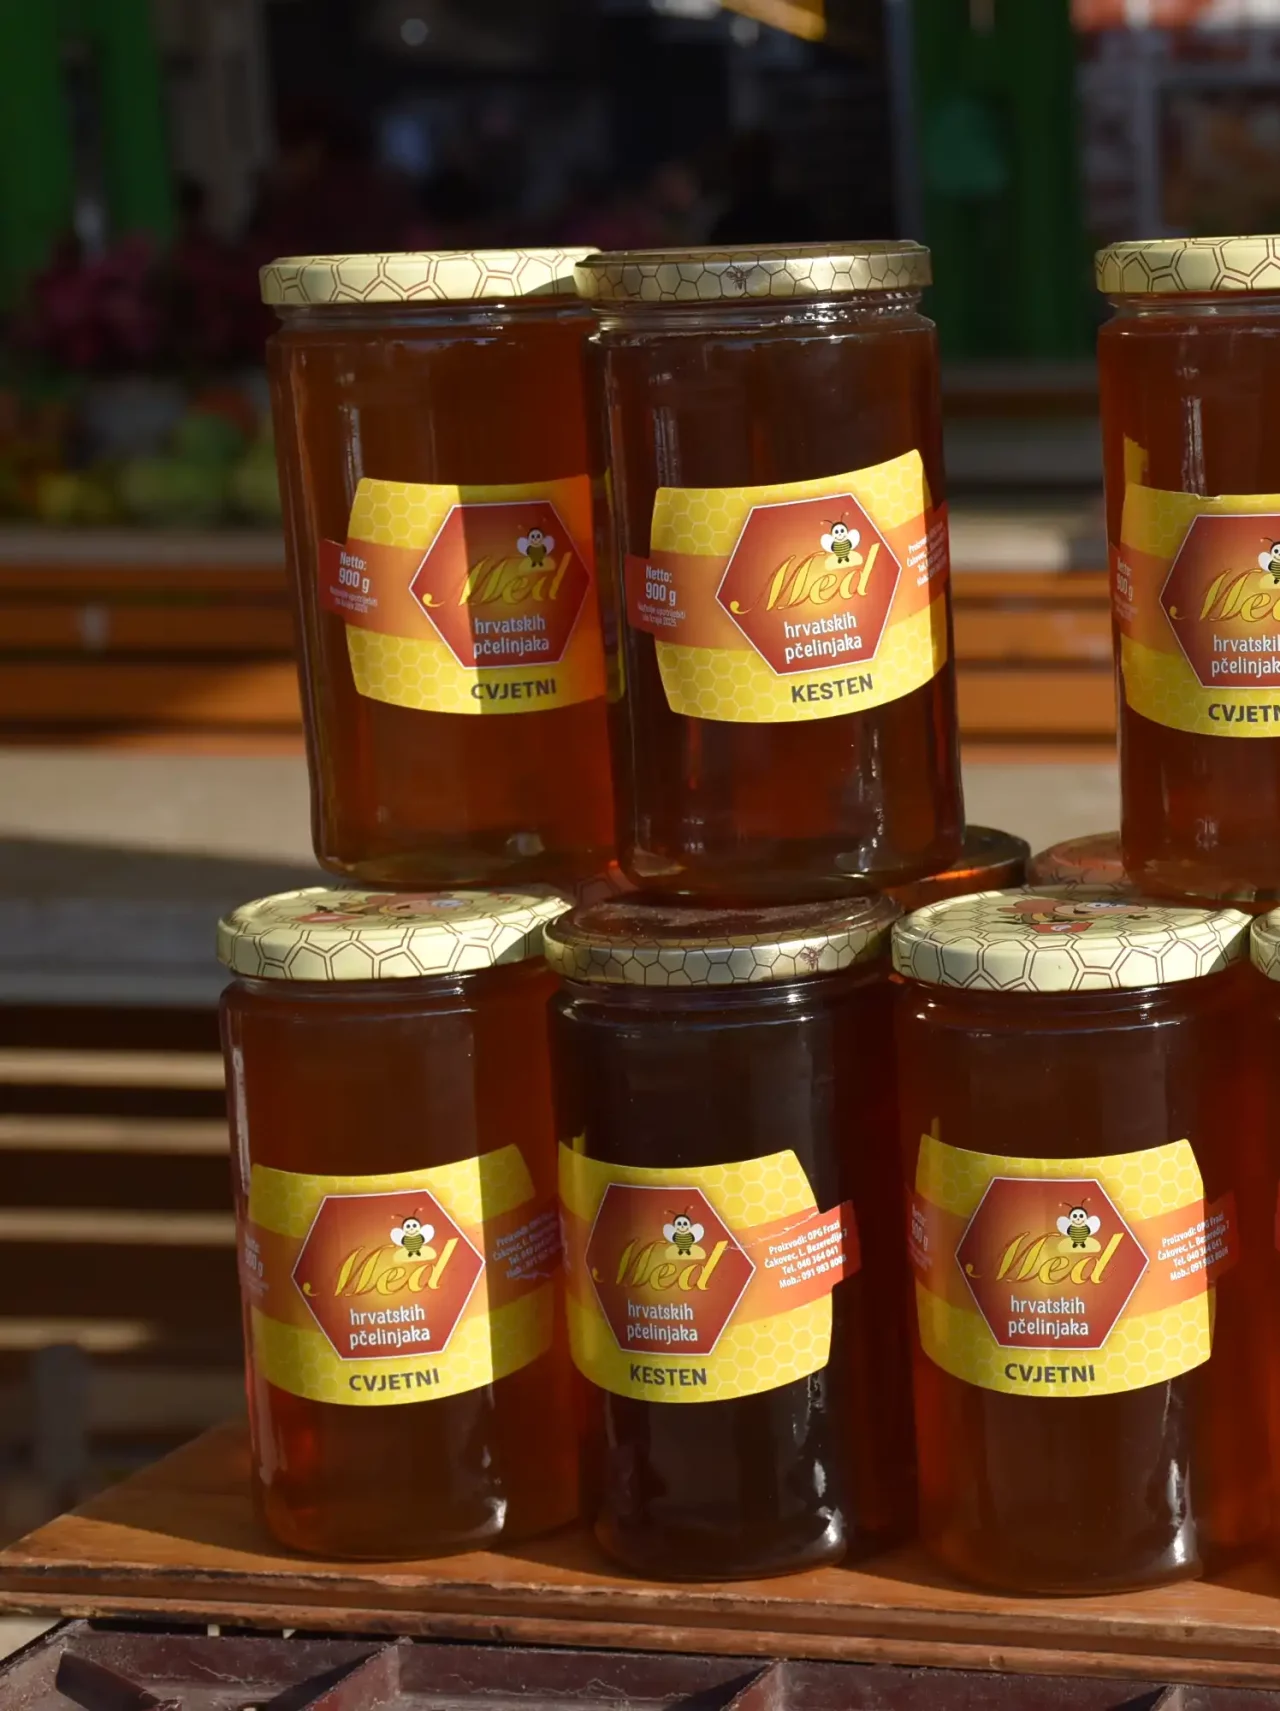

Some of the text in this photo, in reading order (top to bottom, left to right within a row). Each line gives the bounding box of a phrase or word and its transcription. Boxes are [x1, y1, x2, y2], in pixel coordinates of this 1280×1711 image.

[340, 551, 367, 571] Netto:
[339, 567, 369, 593] 900 g
[421, 551, 573, 608] Med
[646, 564, 672, 583] Netto:
[730, 542, 880, 615] Med
[646, 582, 676, 606] 900 g
[475, 614, 545, 636] hrvatskih
[784, 611, 857, 639] hrvatskih
[473, 635, 549, 659] pčelinjaka
[785, 633, 862, 664] pčelinjaka
[471, 678, 557, 700] CVJETNI
[791, 673, 873, 703] KESTEN
[768, 1235, 807, 1255] Proizvodi:
[807, 1227, 823, 1240] OPG
[1162, 1227, 1196, 1247] Proizvodi:
[302, 1237, 459, 1297] Med
[592, 1239, 728, 1291] Med
[782, 1264, 797, 1275] Tel.
[965, 1231, 1124, 1285] Med
[1173, 1257, 1186, 1267] Tel.
[350, 1304, 425, 1326] hrvatskih
[627, 1299, 693, 1321] hrvatskih
[1010, 1295, 1085, 1315] hrvatskih
[349, 1326, 431, 1350] pčelinjaka
[627, 1323, 698, 1344] pčelinjaka
[1008, 1317, 1089, 1339] pčelinjaka
[349, 1367, 440, 1392] CVJETNI
[630, 1363, 707, 1386] KESTEN
[1004, 1363, 1095, 1384] CVJETNI
